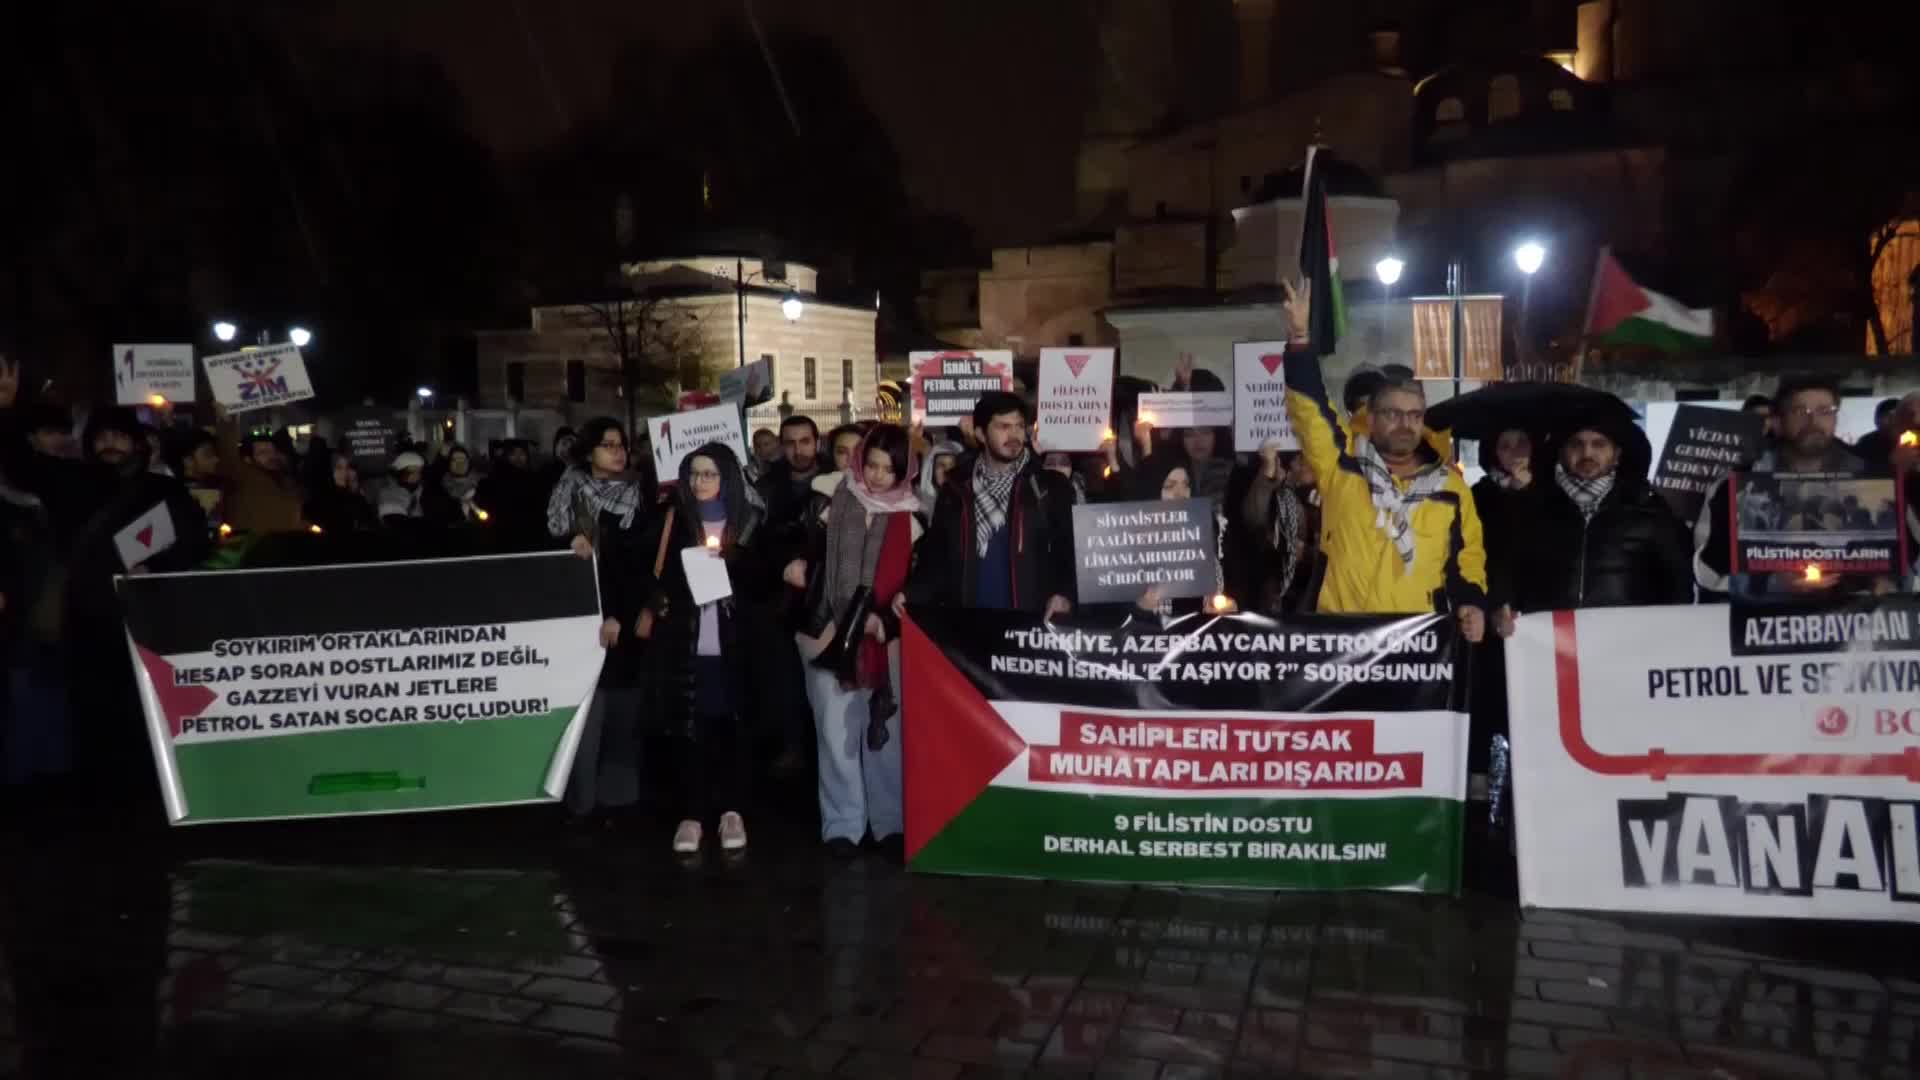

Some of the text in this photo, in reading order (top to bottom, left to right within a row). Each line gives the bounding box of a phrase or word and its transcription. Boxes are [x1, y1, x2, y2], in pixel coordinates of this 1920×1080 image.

[1096, 508, 1189, 528] SİYONİSTLER
[1087, 526, 1201, 549] FAALİYETLERİNİ
[1084, 548, 1206, 569] LİMANLARIMIZDA
[1097, 567, 1195, 586] SÜRDÜRÜYOR
[321, 625, 507, 651] ORTAKLARINDAN
[175, 645, 550, 685] HESAP SORAN DOSTLARIMIZ DEĞİL,
[990, 654, 1064, 678] NEDEN
[1067, 657, 1163, 681] İSRAİL'E
[1167, 661, 1272, 685] TAŞIYOR
[1303, 662, 1454, 682] SORUSUNUN
[227, 676, 498, 706] GAZZEYİ VURAN JETLERE
[1647, 663, 1749, 699] PETROL
[1756, 662, 1793, 696] VE
[182, 697, 550, 734] PETROL SATAN SOCAR SUÇLUDUR!
[1080, 722, 1352, 752] SAHİPLERİ TUTSAK
[1049, 752, 1406, 787] MUHATAPLARI DIŞARIDA
[1114, 811, 1313, 833] 9 FİLİSTİN DOSTU
[1044, 835, 1387, 862] DERHAL SERBEST BIRAKILSIN!
